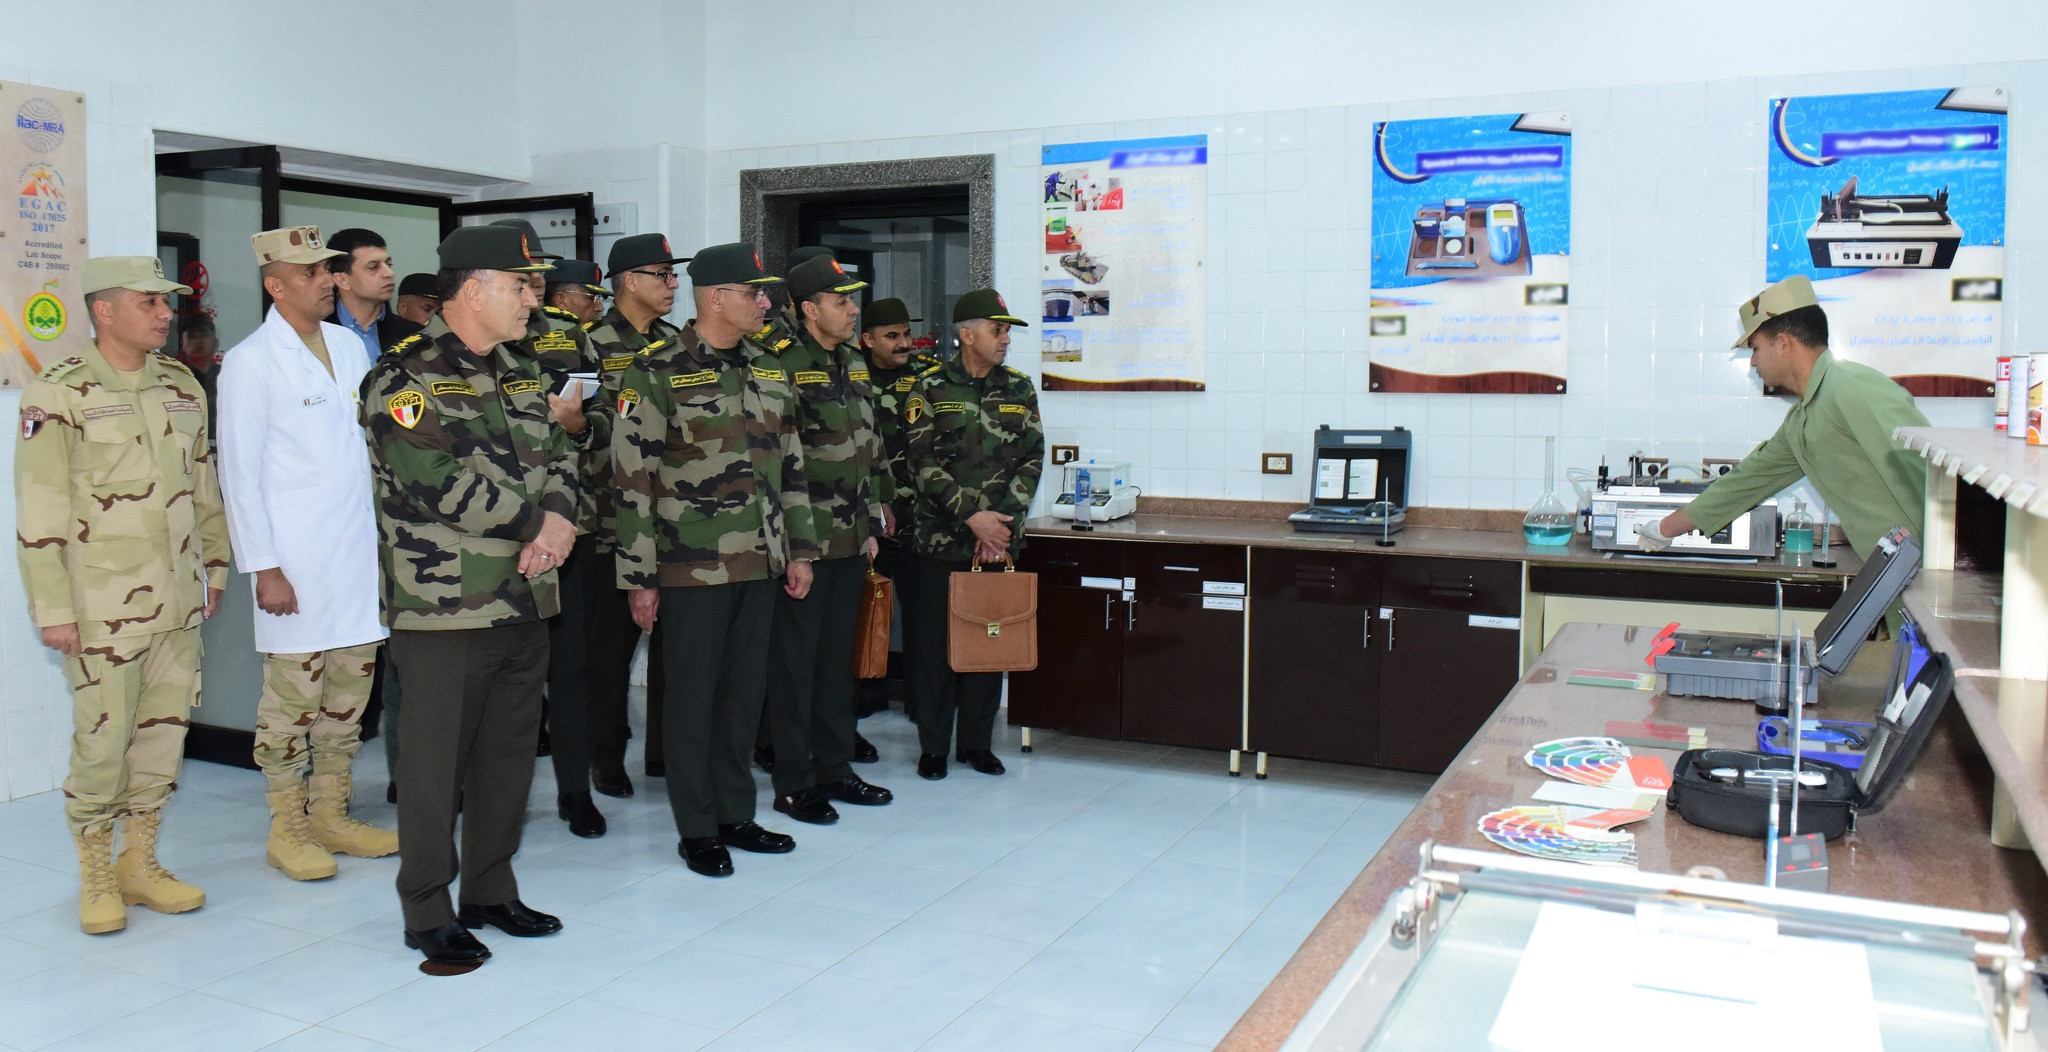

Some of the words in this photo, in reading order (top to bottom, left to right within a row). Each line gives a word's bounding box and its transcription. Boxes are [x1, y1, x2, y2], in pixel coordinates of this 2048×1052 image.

[16, 114, 65, 134] ilac-MRA
[19, 210, 37, 220] ISO
[42, 212, 67, 222] 17025
[32, 222, 55, 233] 2017
[25, 240, 63, 250] Accredited
[26, 251, 39, 260] Lab
[41, 252, 63, 263] Scope
[18, 261, 34, 269] CAB
[393, 396, 419, 408] EGYPT
